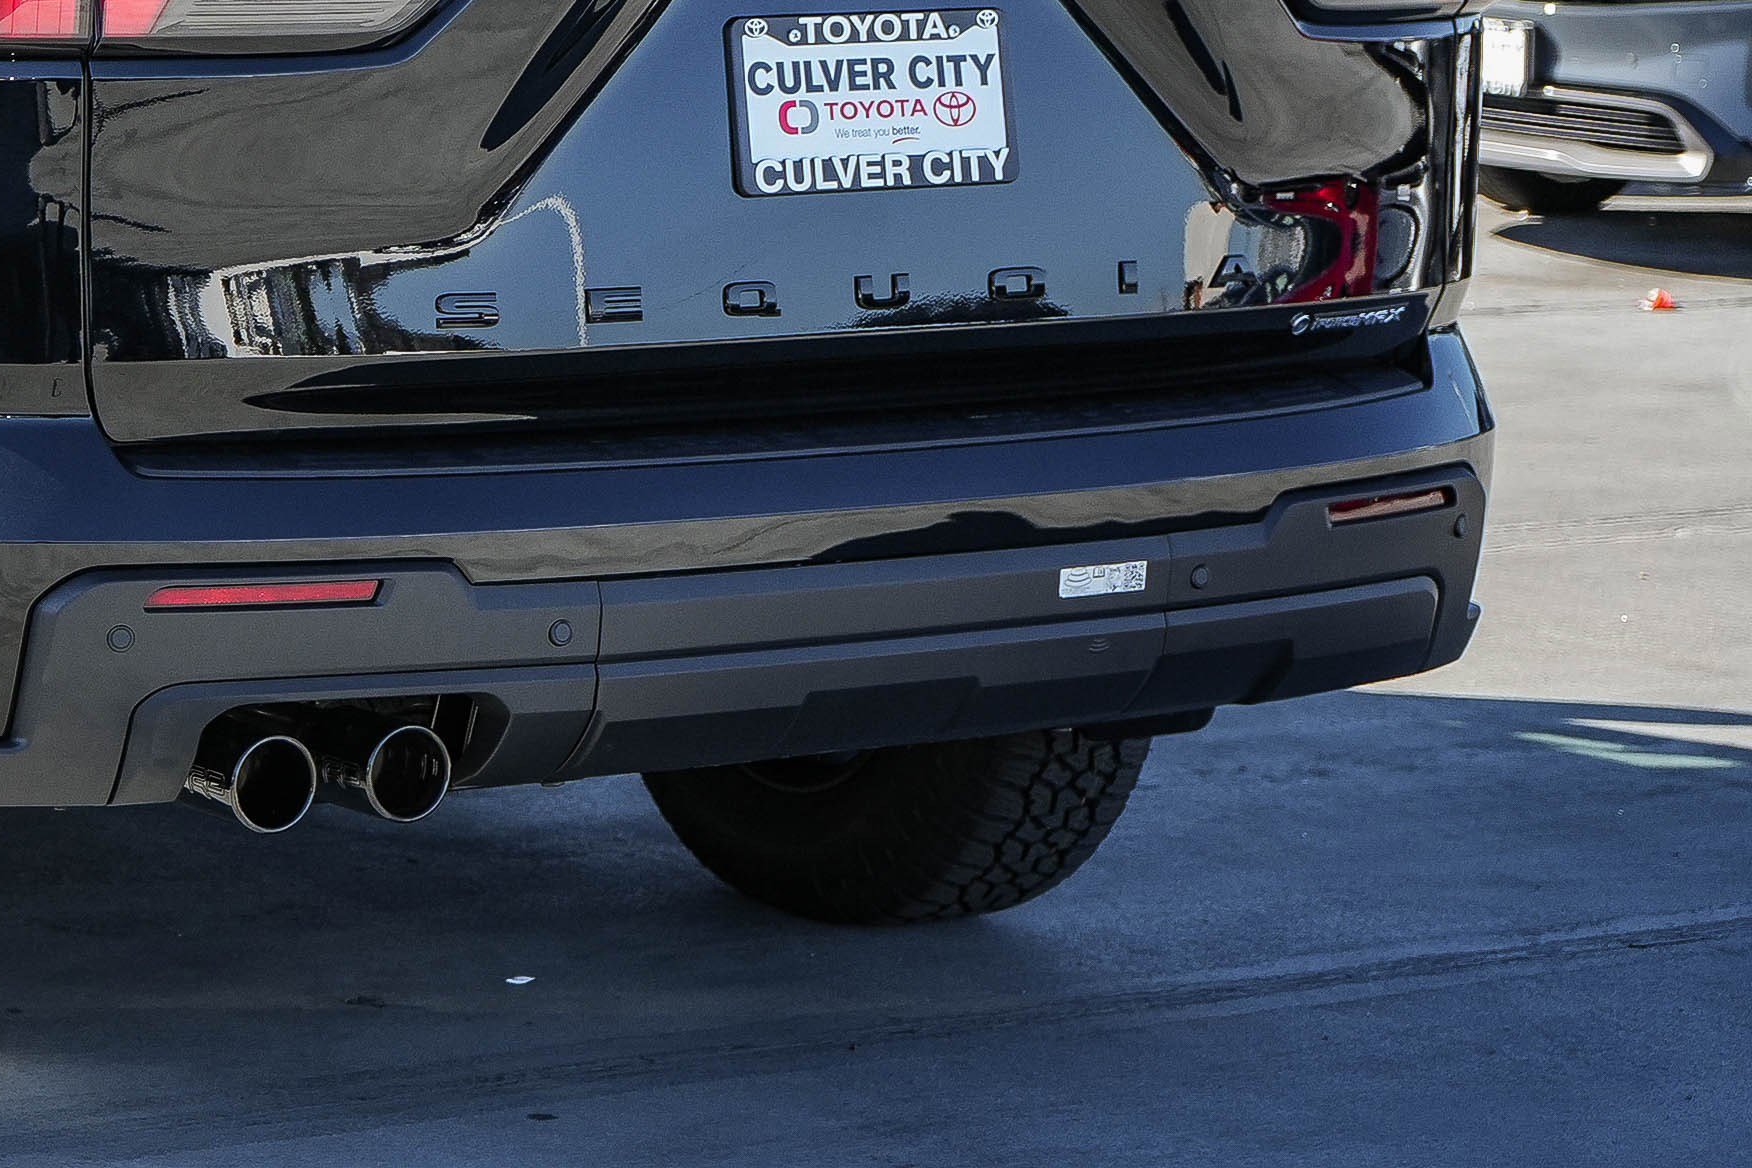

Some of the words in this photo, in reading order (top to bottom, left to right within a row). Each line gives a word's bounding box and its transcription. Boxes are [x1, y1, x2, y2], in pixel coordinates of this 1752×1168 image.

[799, 12, 949, 44] TOYOTA
[748, 58, 897, 96] CULVER
[908, 53, 996, 89] CITY
[824, 99, 928, 121] TOYOTA
[834, 128, 850, 138] We
[852, 128, 872, 138] treat
[874, 129, 890, 139] you
[755, 155, 911, 194] CULVER
[923, 149, 1010, 183] CITY
[435, 254, 1262, 330] SEQUOIA
